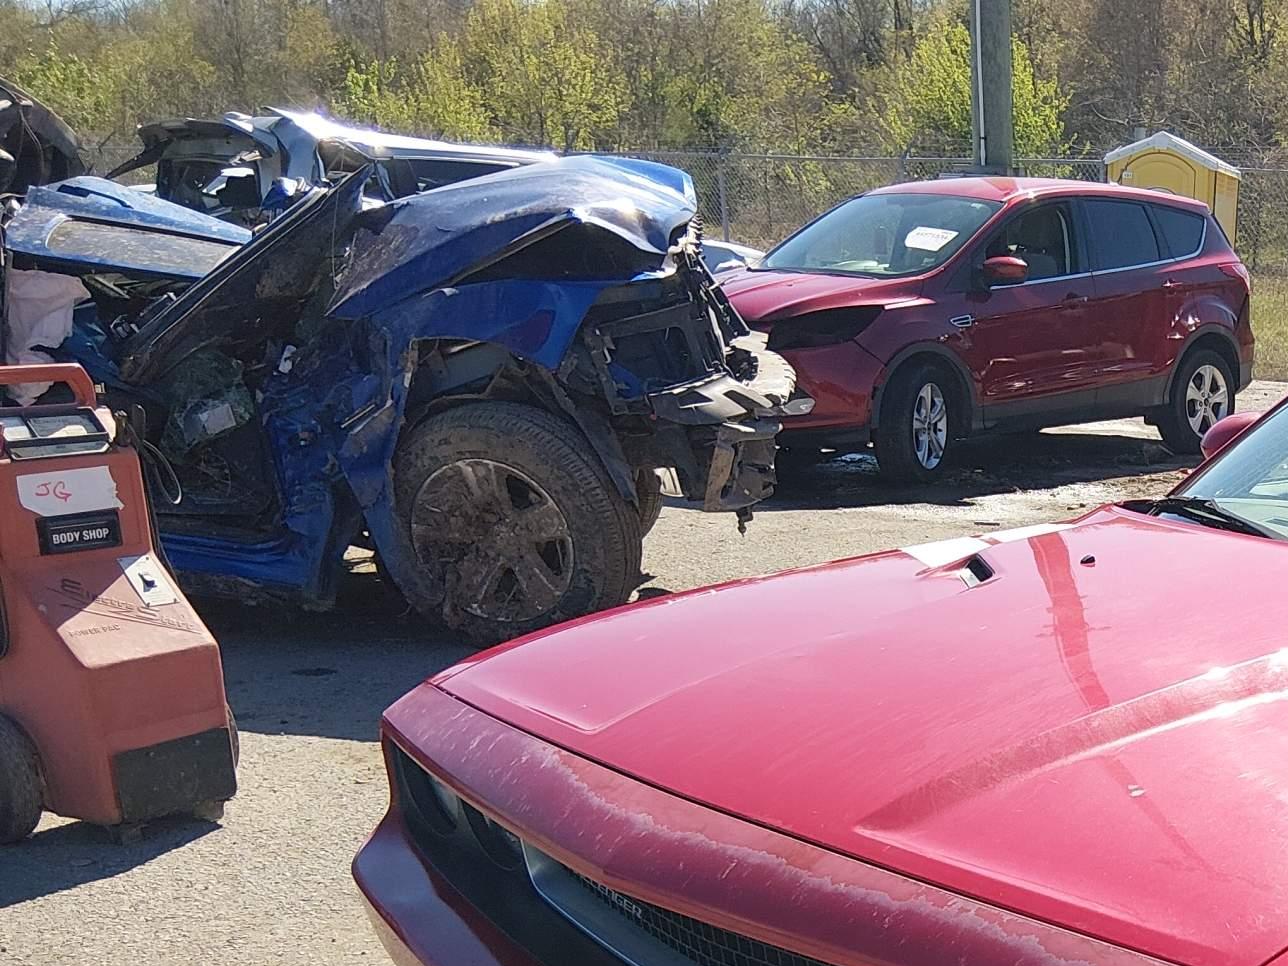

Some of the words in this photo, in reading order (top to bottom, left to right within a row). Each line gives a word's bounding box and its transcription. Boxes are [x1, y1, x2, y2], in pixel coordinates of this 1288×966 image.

[35, 481, 72, 502] JG
[52, 531, 81, 545] BODY
[82, 527, 109, 541] SHOP
